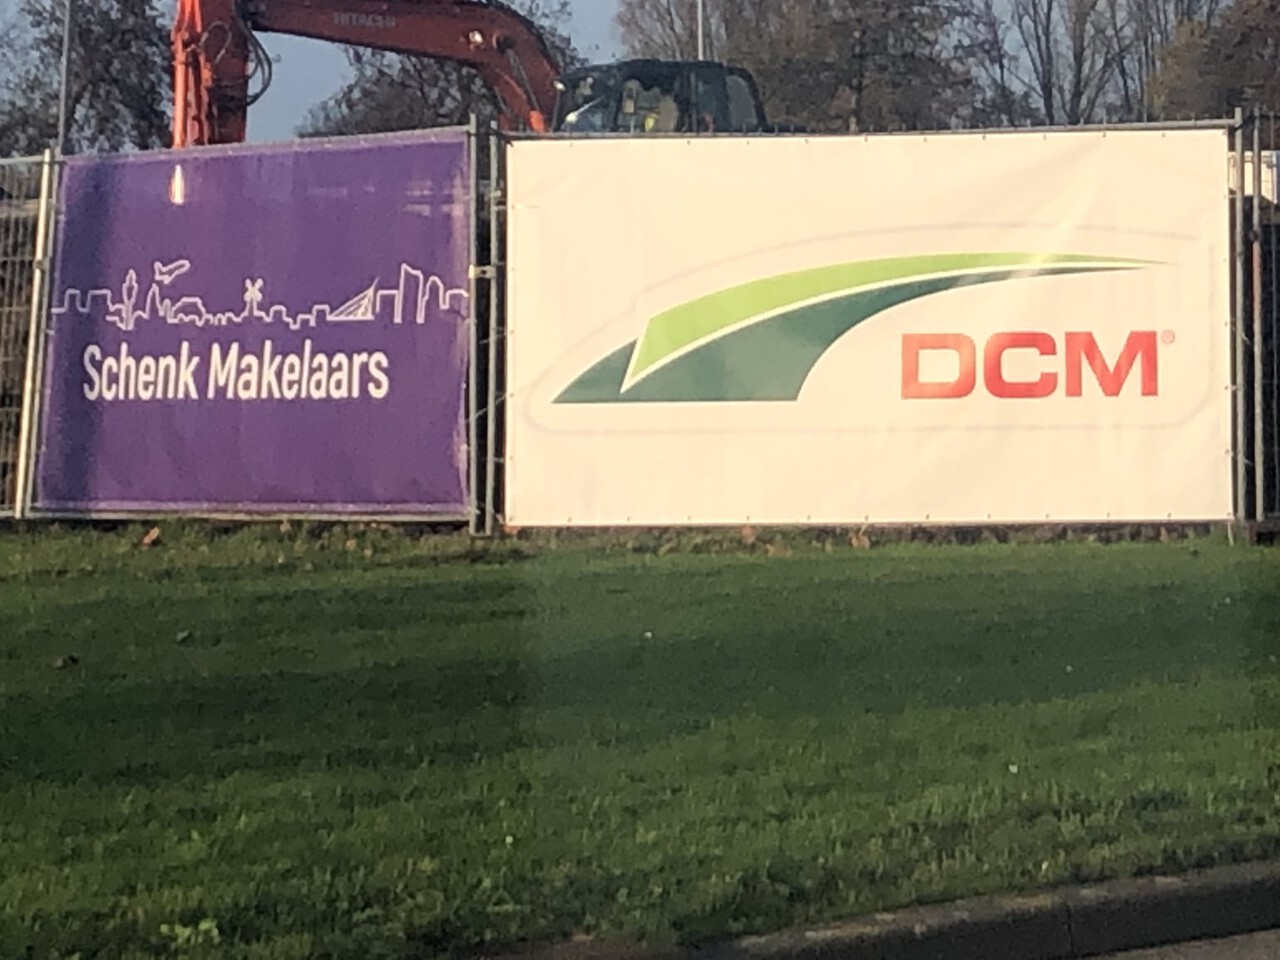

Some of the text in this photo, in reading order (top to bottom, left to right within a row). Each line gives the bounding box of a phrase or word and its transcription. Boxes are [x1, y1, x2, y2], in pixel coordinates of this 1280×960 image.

[333, 12, 396, 29] HITACHI
[83, 338, 390, 401] Schenk Makelaars
[901, 330, 1159, 400] DCM
